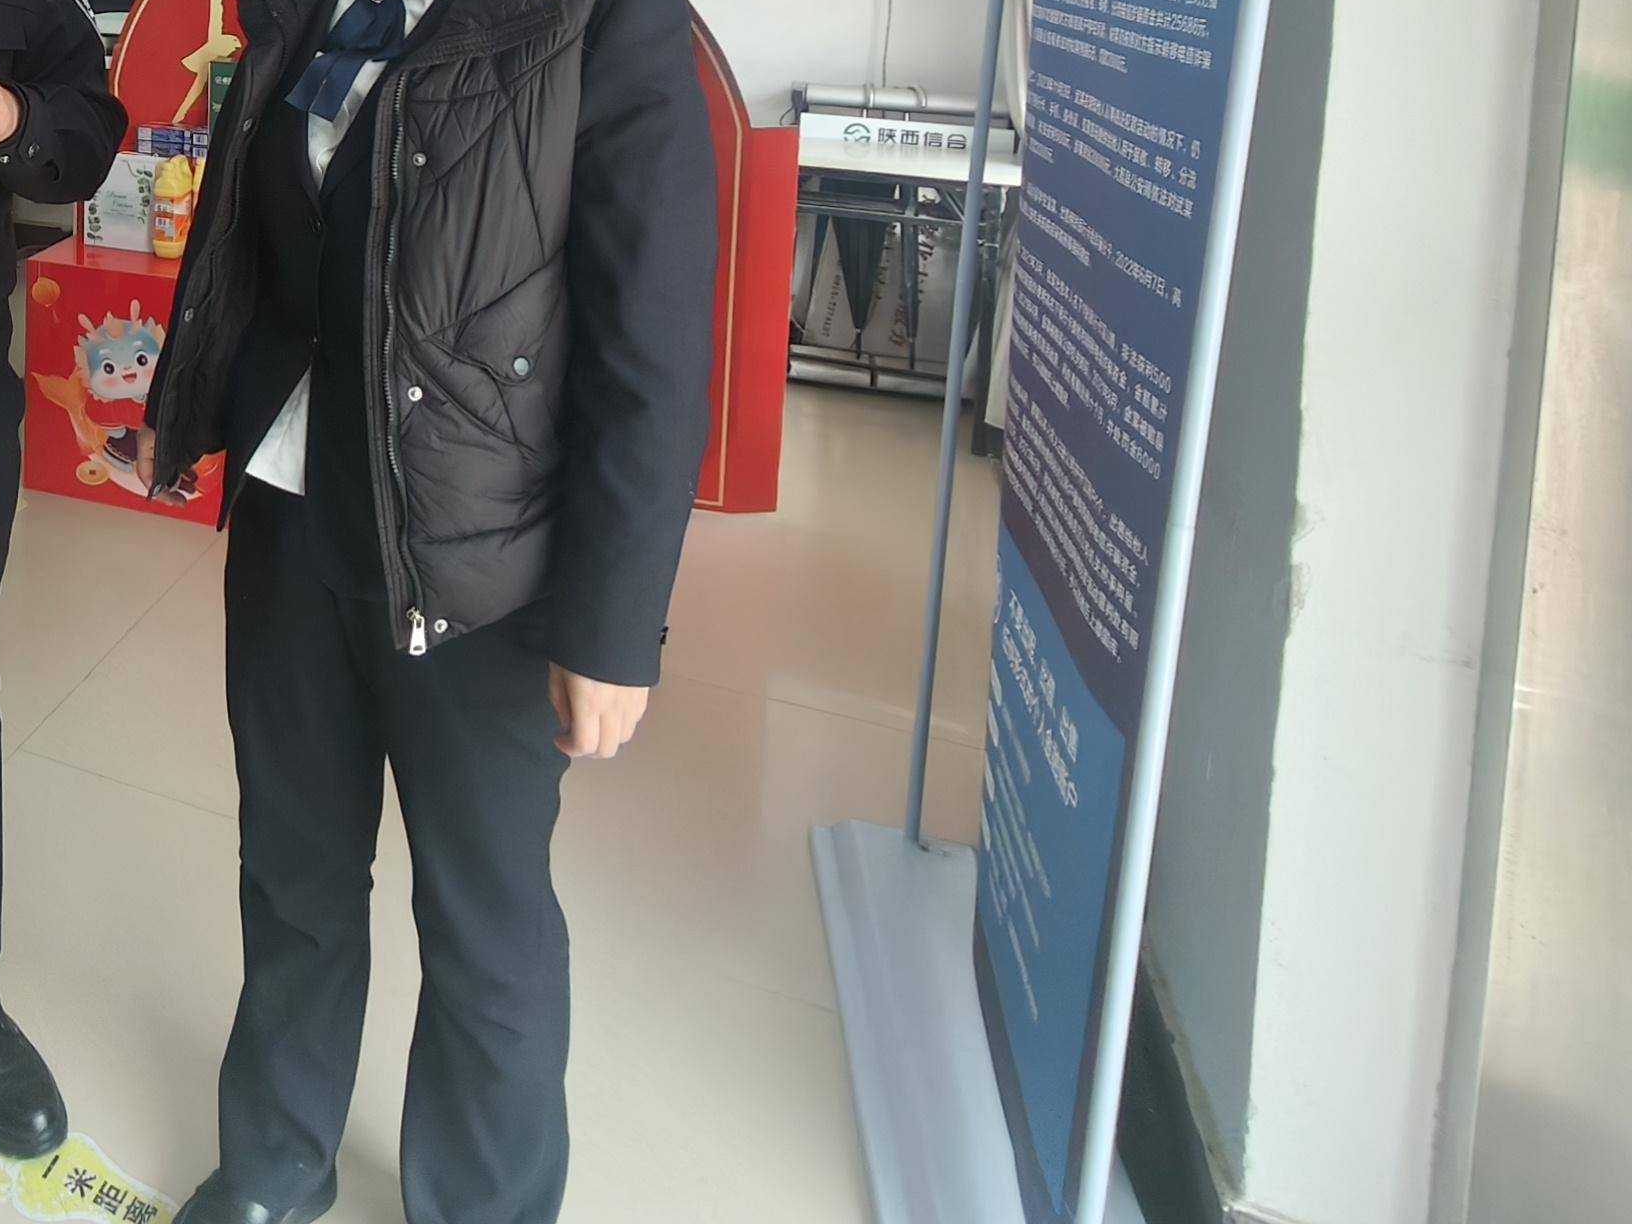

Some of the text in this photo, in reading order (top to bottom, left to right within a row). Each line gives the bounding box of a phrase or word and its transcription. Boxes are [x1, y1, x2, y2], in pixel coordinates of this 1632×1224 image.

[877, 127, 968, 150] 陕西信合
[42, 1154, 159, 1224] 一米距离
